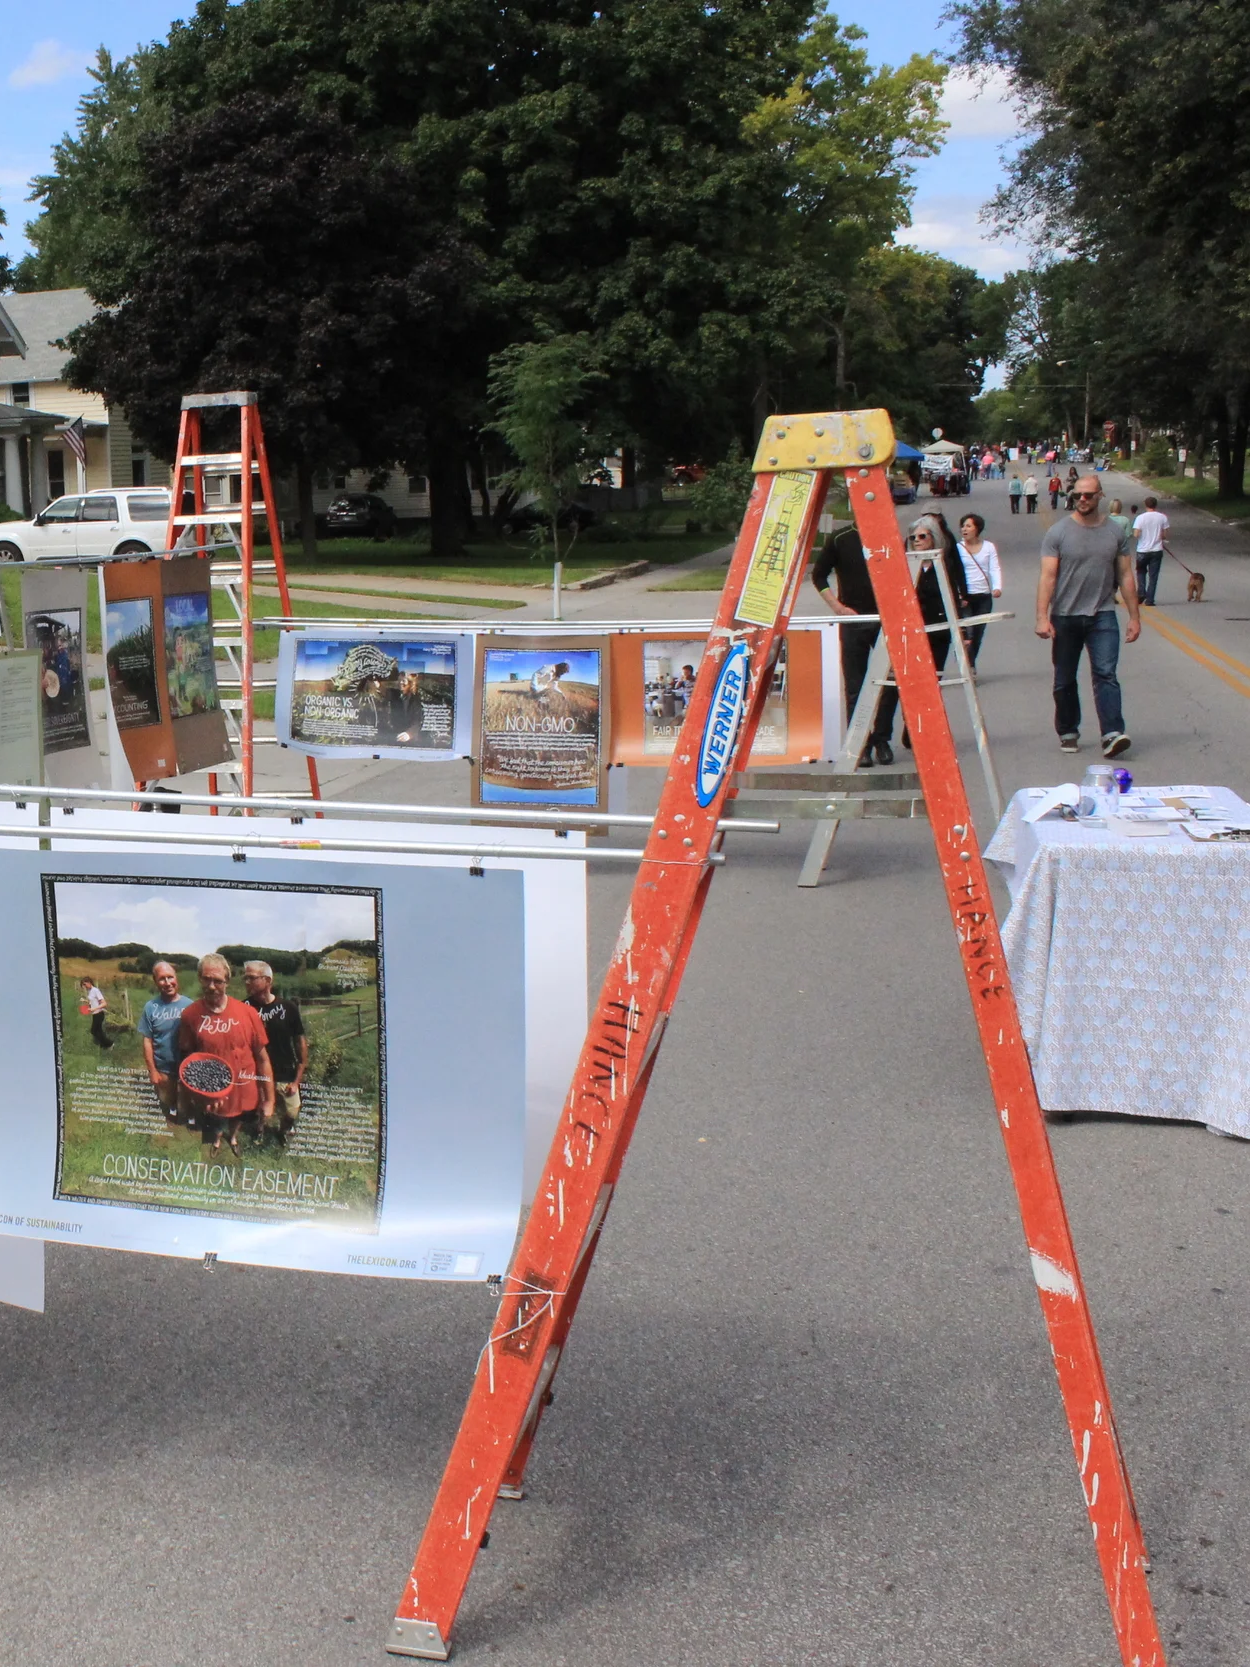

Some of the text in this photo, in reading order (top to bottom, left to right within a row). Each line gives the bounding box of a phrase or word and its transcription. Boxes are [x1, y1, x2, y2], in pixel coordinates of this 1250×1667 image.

[305, 694, 353, 707] ORGANIC VS.
[304, 706, 359, 719] NON-ORGANIC
[506, 715, 575, 732] NON-GMO
[653, 726, 670, 736] FAIR
[704, 670, 742, 776] WERNER
[955, 881, 1006, 1001] HANCE
[199, 1015, 239, 1034] Peter
[572, 1000, 644, 1153] HANCE
[103, 1154, 339, 1199] CONSERVATION EASEMENT
[15, 1218, 24, 1226] OF
[26, 1218, 83, 1233] SUSTAINABILITY
[347, 1254, 417, 1269] THELEXICON.ORG
